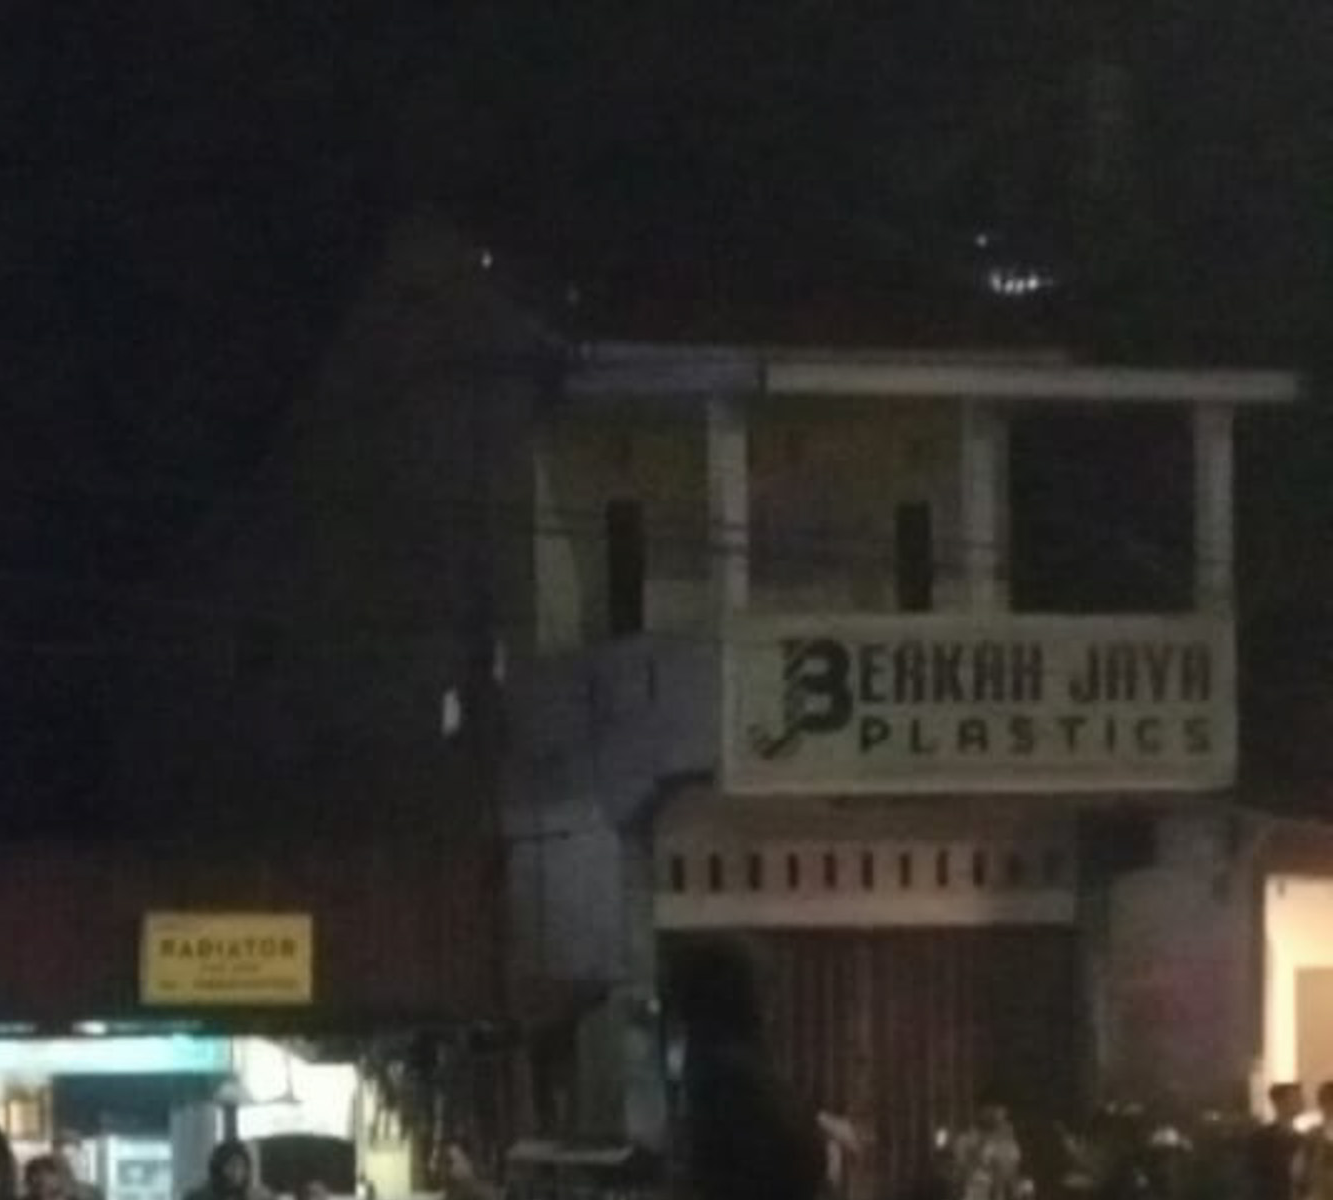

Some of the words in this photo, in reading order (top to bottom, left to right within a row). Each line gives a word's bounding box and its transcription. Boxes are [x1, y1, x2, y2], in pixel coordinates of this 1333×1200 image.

[779, 638, 1043, 732] BERKAH
[1069, 641, 1213, 704] JAYA
[860, 717, 1213, 755] PLASTICS
[160, 937, 297, 960] RADIATOR
